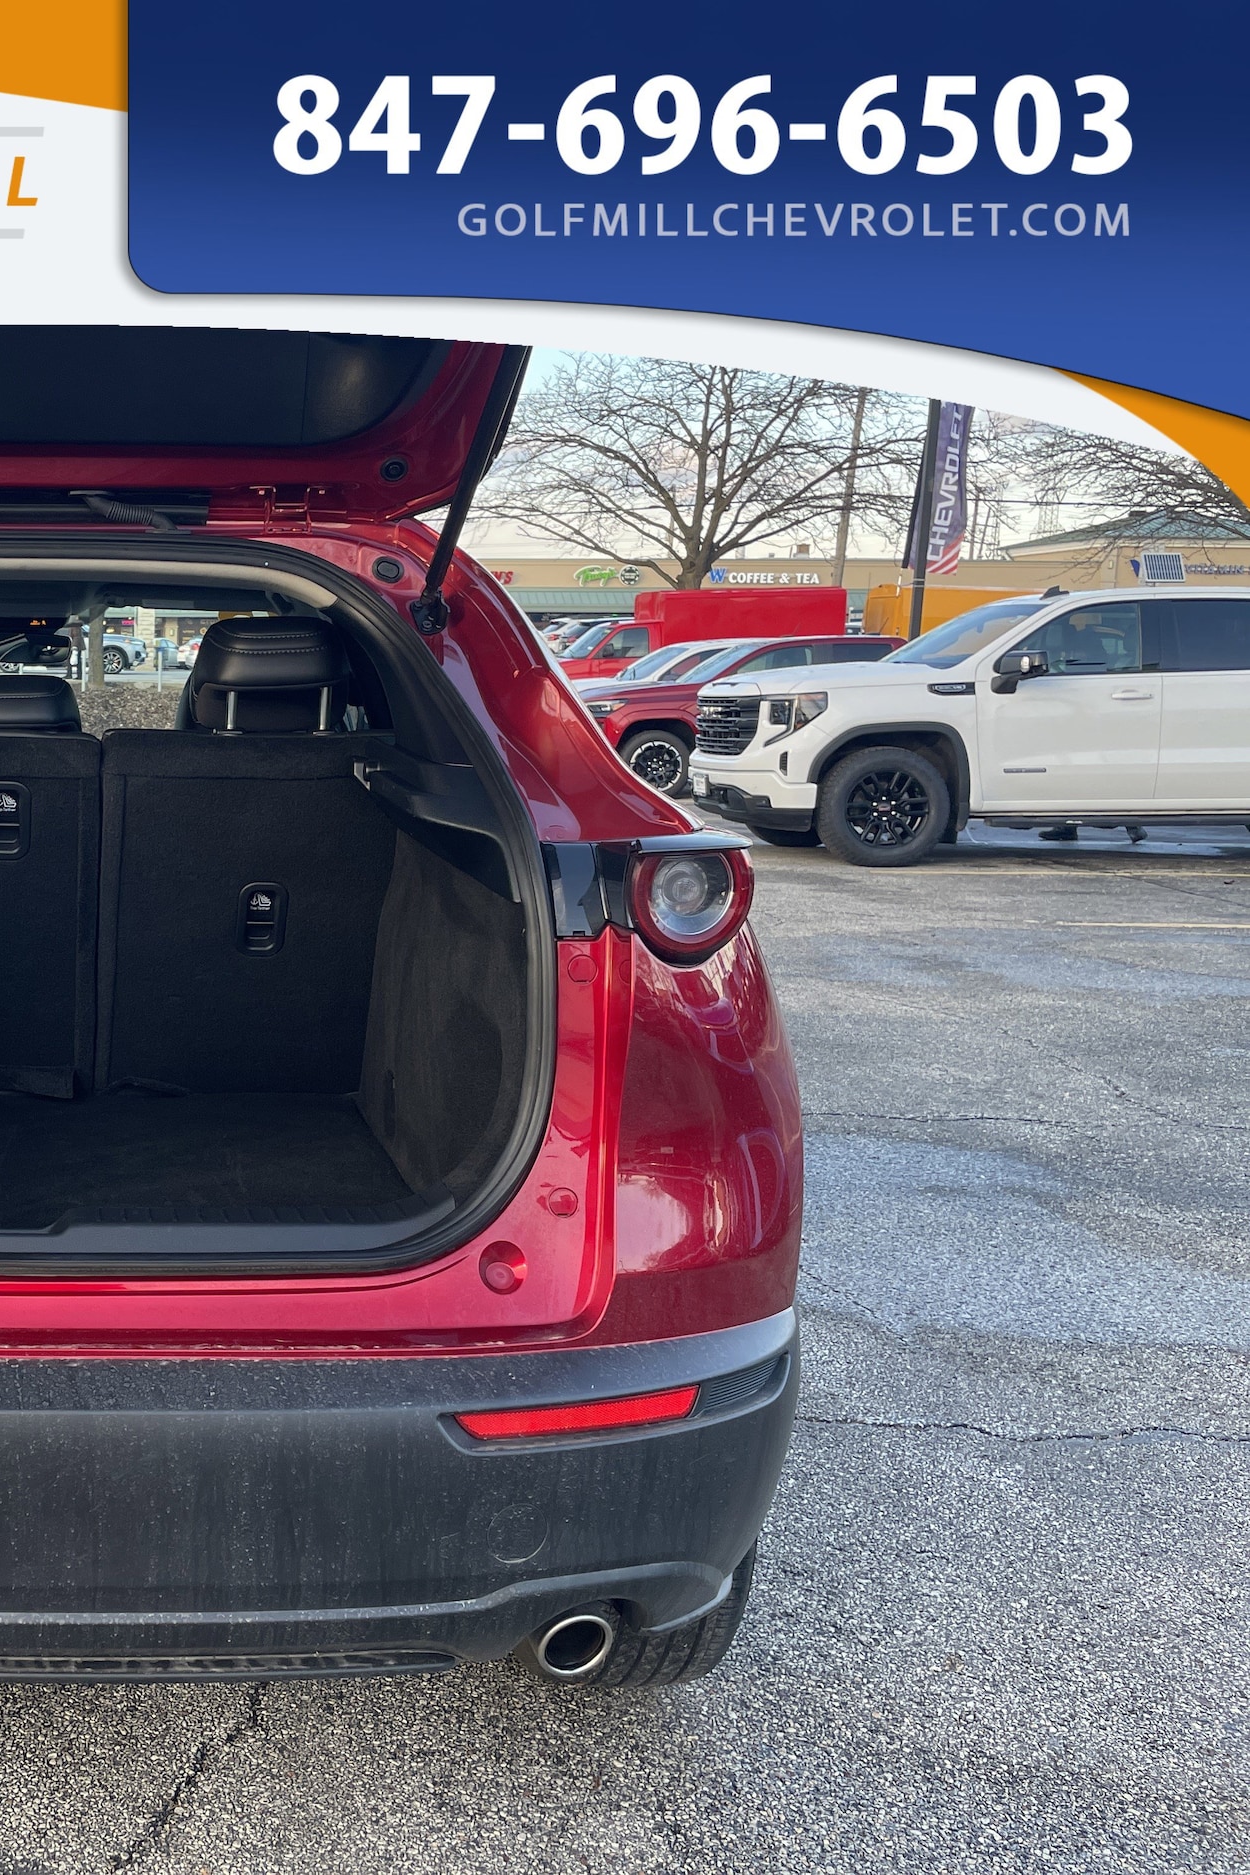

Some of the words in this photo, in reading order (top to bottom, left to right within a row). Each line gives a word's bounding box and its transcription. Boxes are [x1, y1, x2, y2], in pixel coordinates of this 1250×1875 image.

[728, 572, 775, 584] COFFEE
[779, 573, 790, 584] &
[796, 573, 820, 584] TEA
